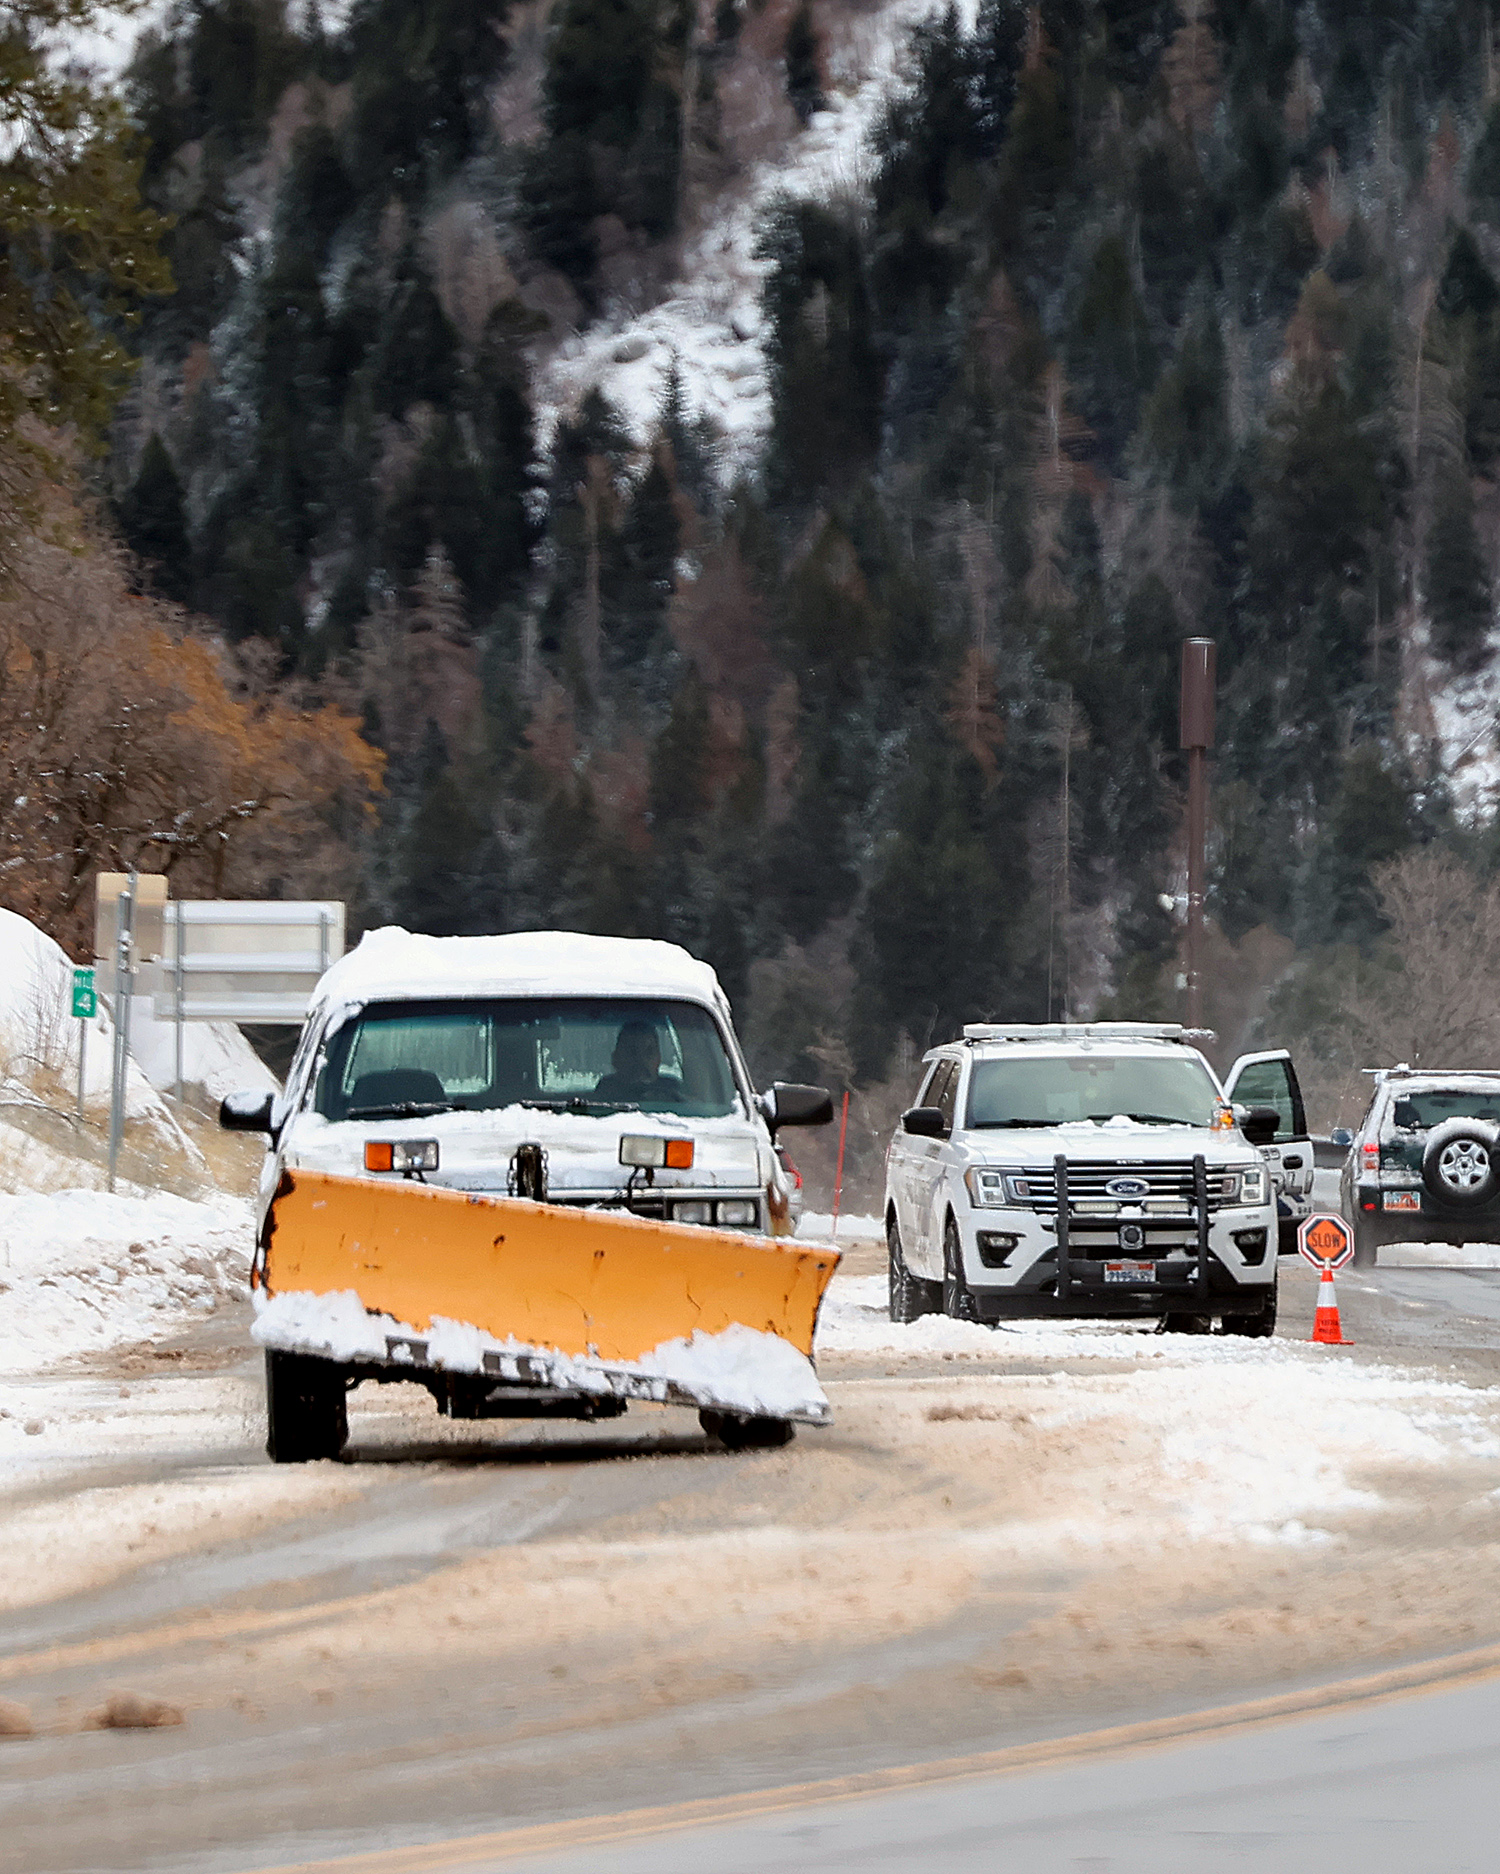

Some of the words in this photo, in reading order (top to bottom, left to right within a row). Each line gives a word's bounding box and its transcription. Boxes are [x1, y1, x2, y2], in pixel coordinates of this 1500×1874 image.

[75, 992, 92, 1012] 4
[1116, 1184, 1139, 1193] Ford
[1311, 1232, 1341, 1248] SLOW
